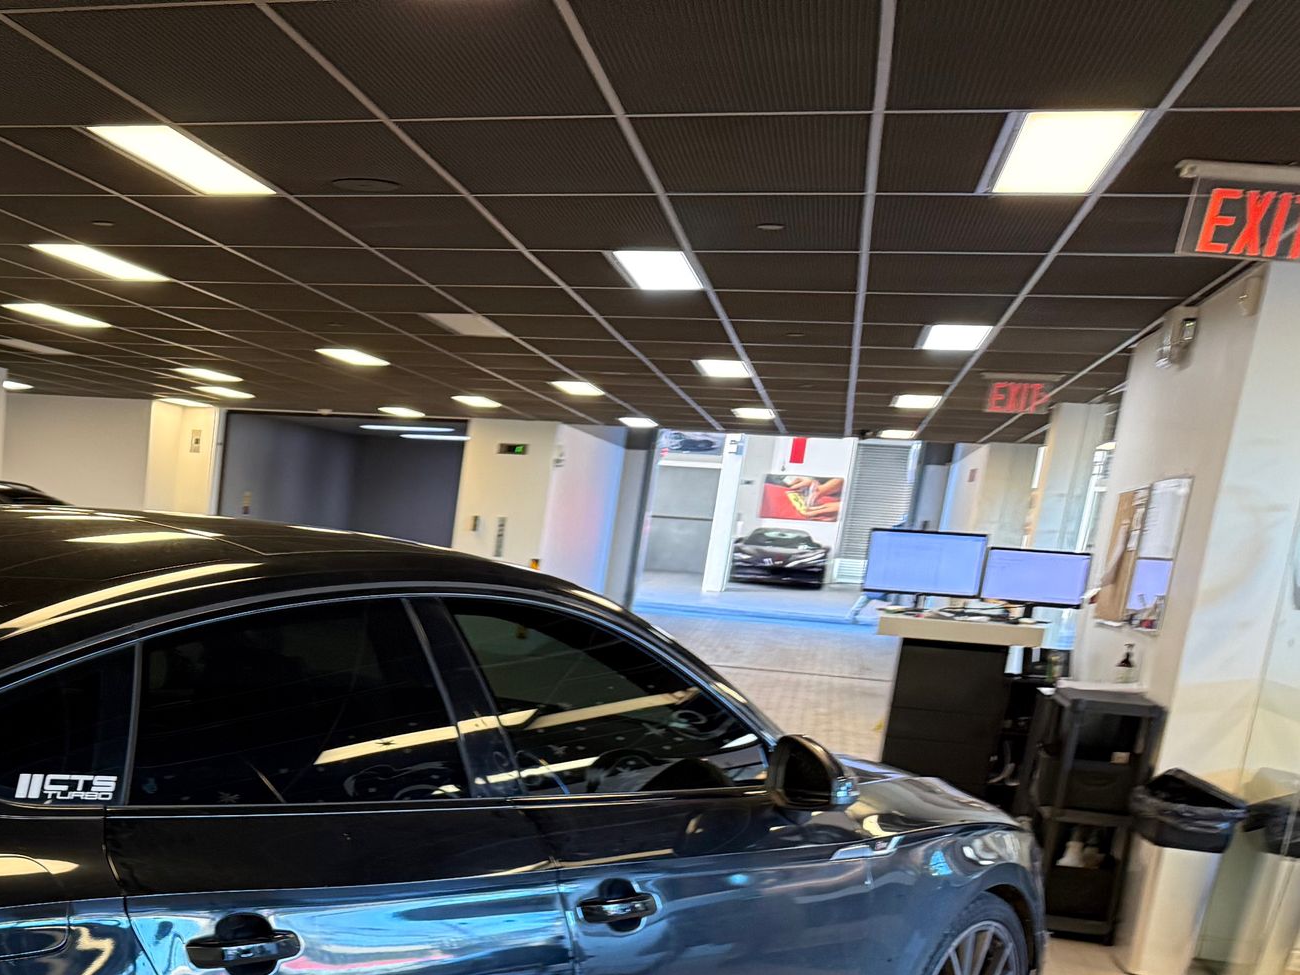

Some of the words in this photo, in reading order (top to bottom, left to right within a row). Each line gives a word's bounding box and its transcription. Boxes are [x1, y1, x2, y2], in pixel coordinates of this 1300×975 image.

[987, 382, 1044, 415] EXIT
[43, 774, 118, 792] CTS
[43, 790, 113, 801] TURBO
